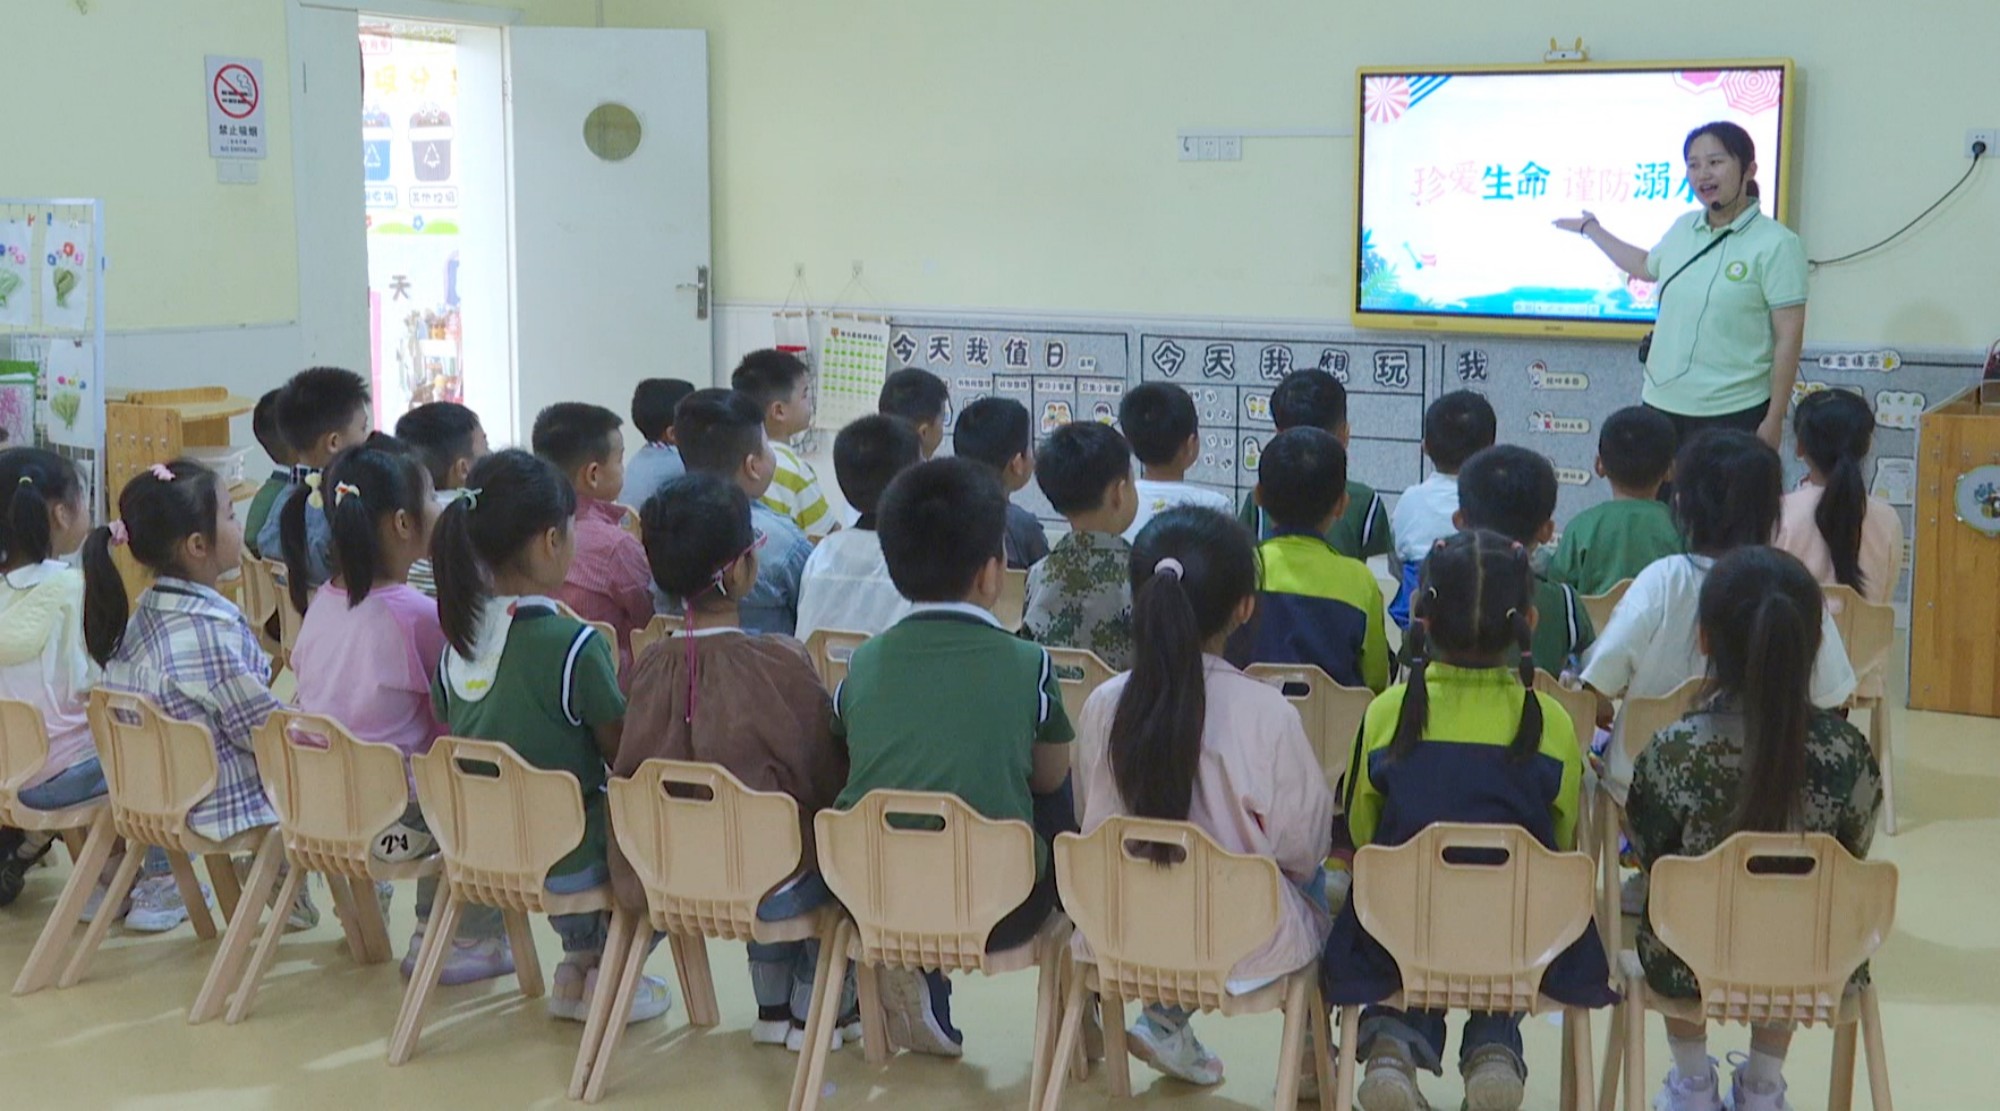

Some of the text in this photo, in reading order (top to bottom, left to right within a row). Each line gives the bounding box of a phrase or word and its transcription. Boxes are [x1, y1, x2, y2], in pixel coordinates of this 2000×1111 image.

[219, 124, 258, 137] 禁止吸烟
[1410, 160, 1550, 205] 珍爱生命
[389, 275, 411, 301] 天
[893, 333, 1064, 368] 今天我值日
[1157, 346, 1406, 385] 今天我想玩
[1459, 350, 1488, 381] 我
